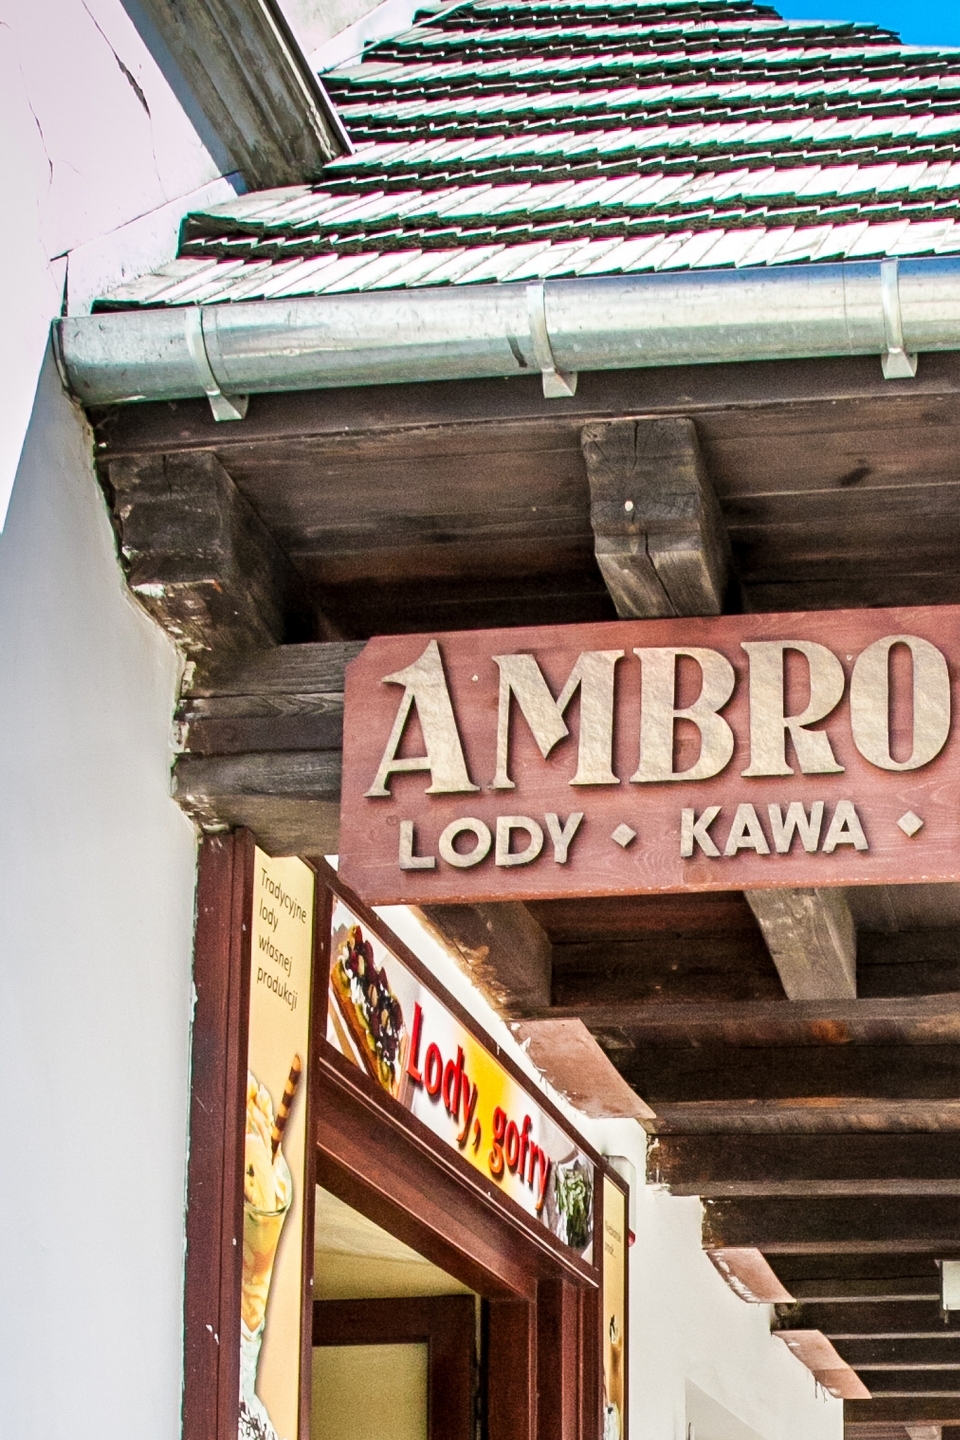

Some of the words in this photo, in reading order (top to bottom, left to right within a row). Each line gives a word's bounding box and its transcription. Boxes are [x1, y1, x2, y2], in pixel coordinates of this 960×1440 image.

[398, 811, 583, 870] LODY
[678, 800, 870, 858] KAWA
[258, 898, 279, 933] lody
[261, 867, 308, 925] Tradycyjne
[258, 934, 293, 978] własnej
[256, 966, 298, 1012] produkcji
[406, 1001, 481, 1148] Lody,
[488, 1105, 550, 1211] gofry
